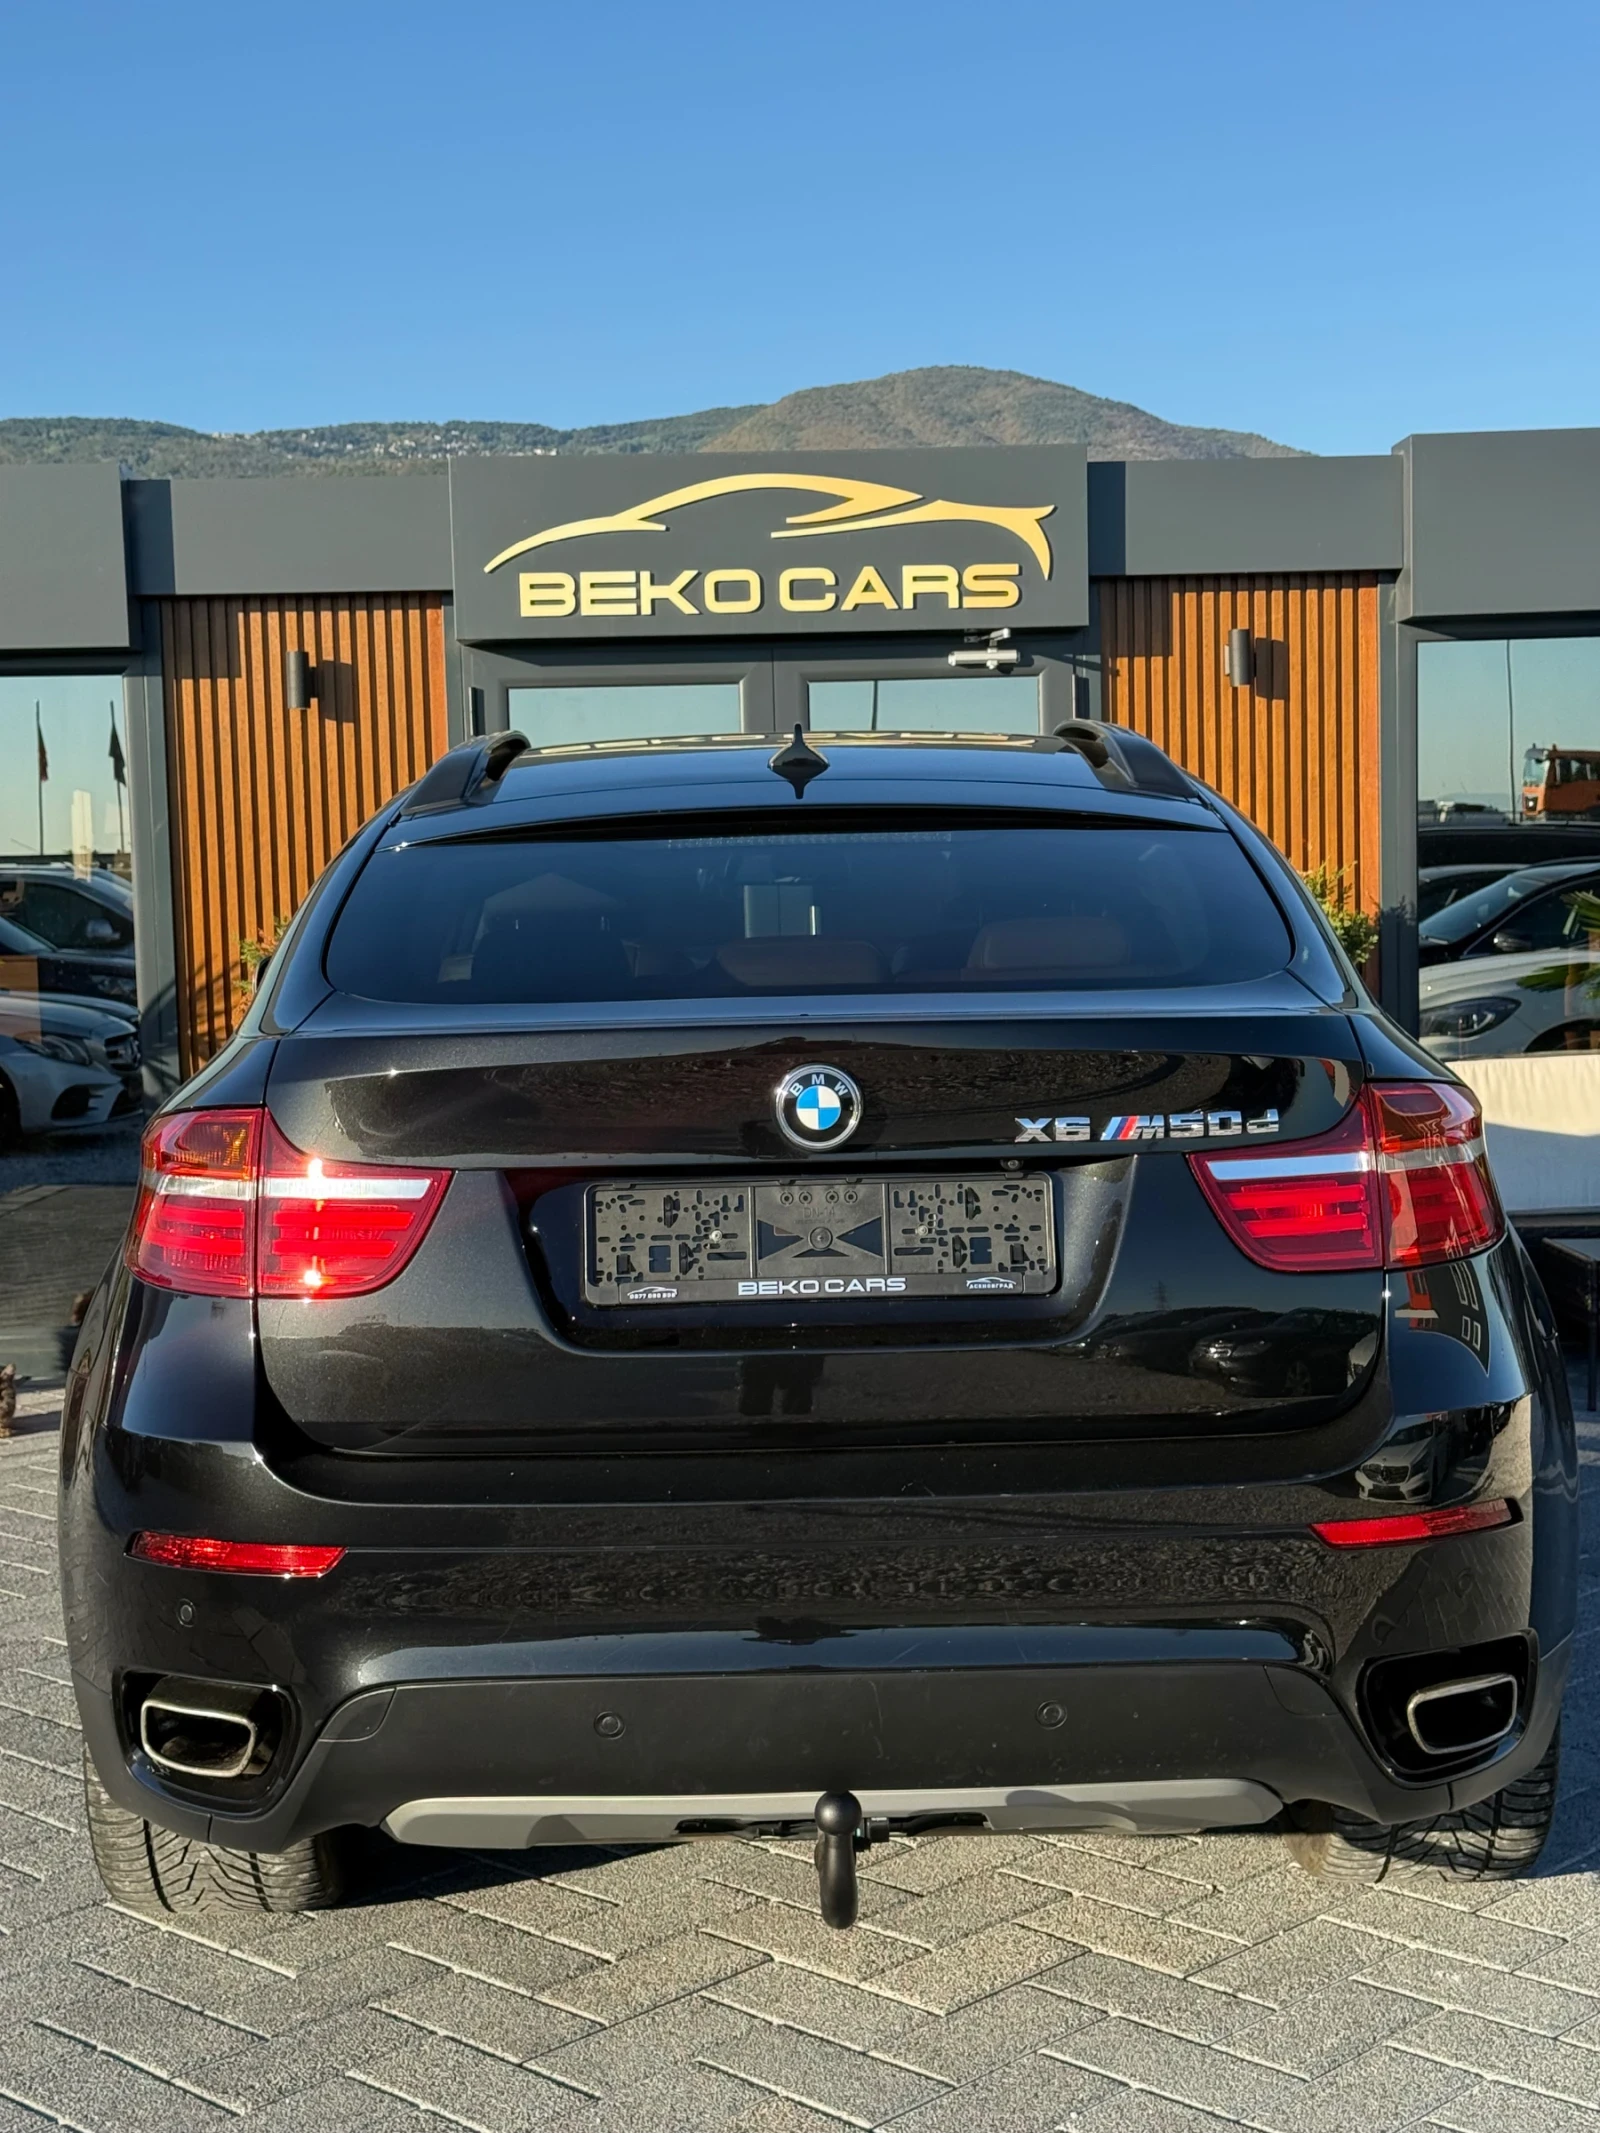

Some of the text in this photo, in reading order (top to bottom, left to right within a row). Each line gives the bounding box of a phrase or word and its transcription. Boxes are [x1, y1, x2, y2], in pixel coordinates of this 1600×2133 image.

[519, 563, 1021, 618] BEKO CARS
[789, 1074, 849, 1097] BMW
[1014, 1116, 1091, 1142] X6
[738, 1277, 907, 1296] BEKO CARS
